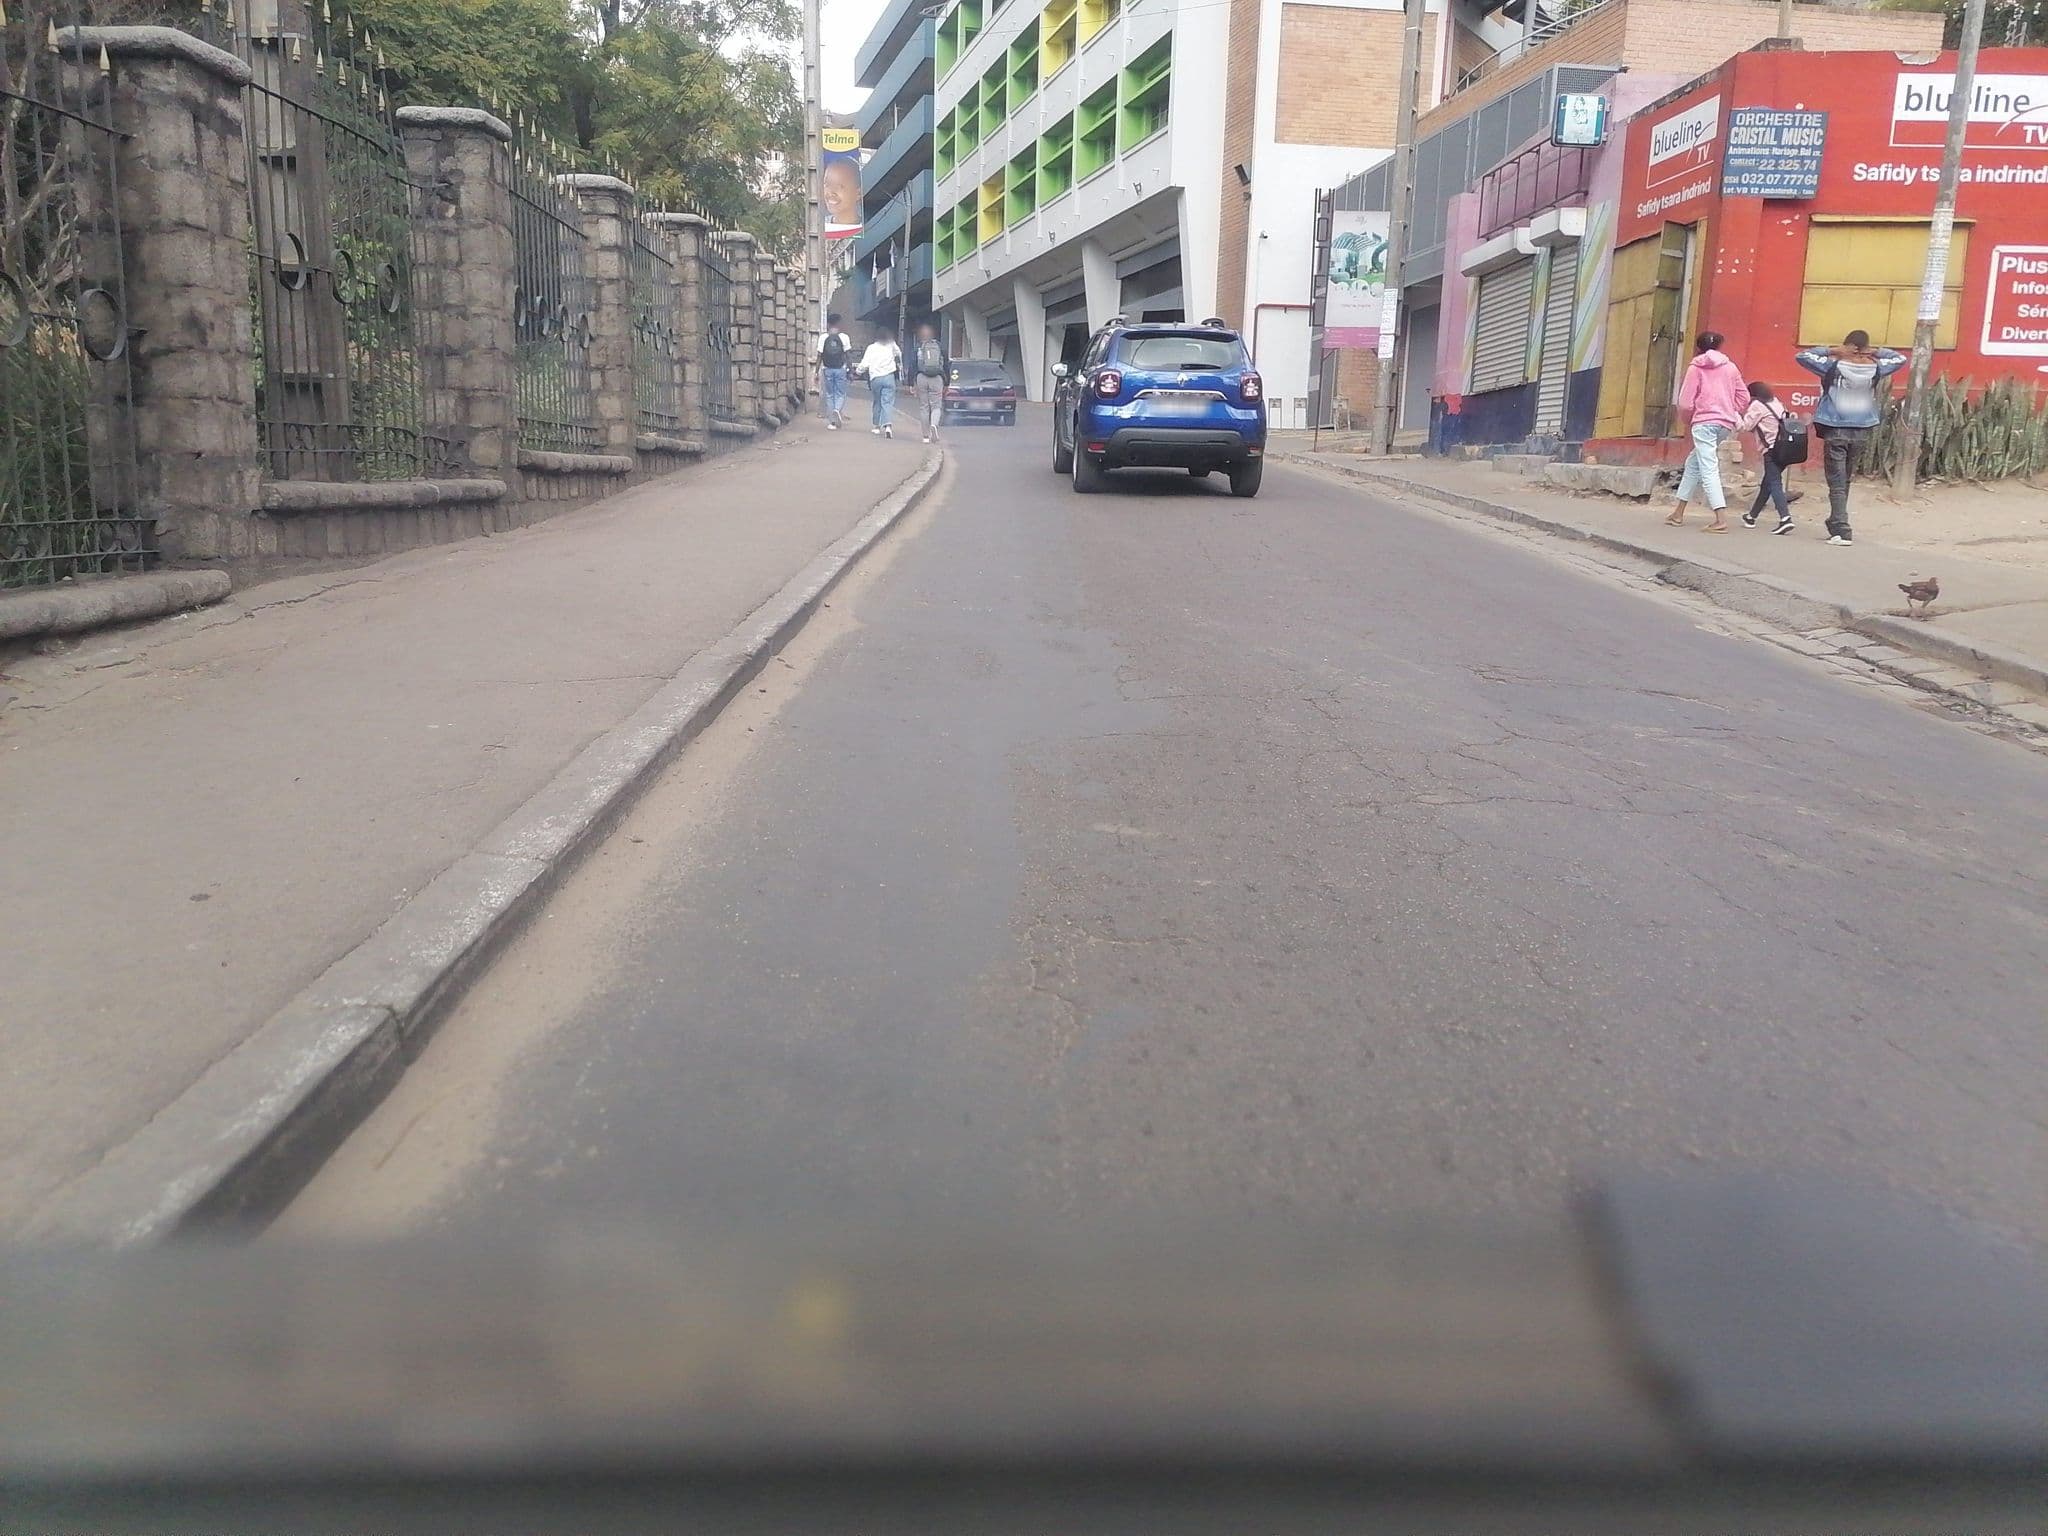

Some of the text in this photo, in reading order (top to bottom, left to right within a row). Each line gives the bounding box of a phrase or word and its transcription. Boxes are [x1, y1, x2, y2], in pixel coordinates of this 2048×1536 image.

[1904, 84, 2030, 113] bluline
[1736, 113, 1823, 126] ORCHESTRE
[824, 133, 854, 145] Telma
[1653, 120, 1702, 157] blueline
[1730, 127, 1824, 146] CRISTAL MUSIC
[2023, 125, 2048, 144] TV
[1697, 143, 1711, 163] TV
[1853, 162, 1918, 186] Safidy
[1921, 165, 1972, 182] tsa
[1637, 198, 1661, 219] Safidy
[1661, 191, 1681, 210] tsara
[2001, 256, 2048, 274] Plus
[2012, 280, 2048, 294] Info
